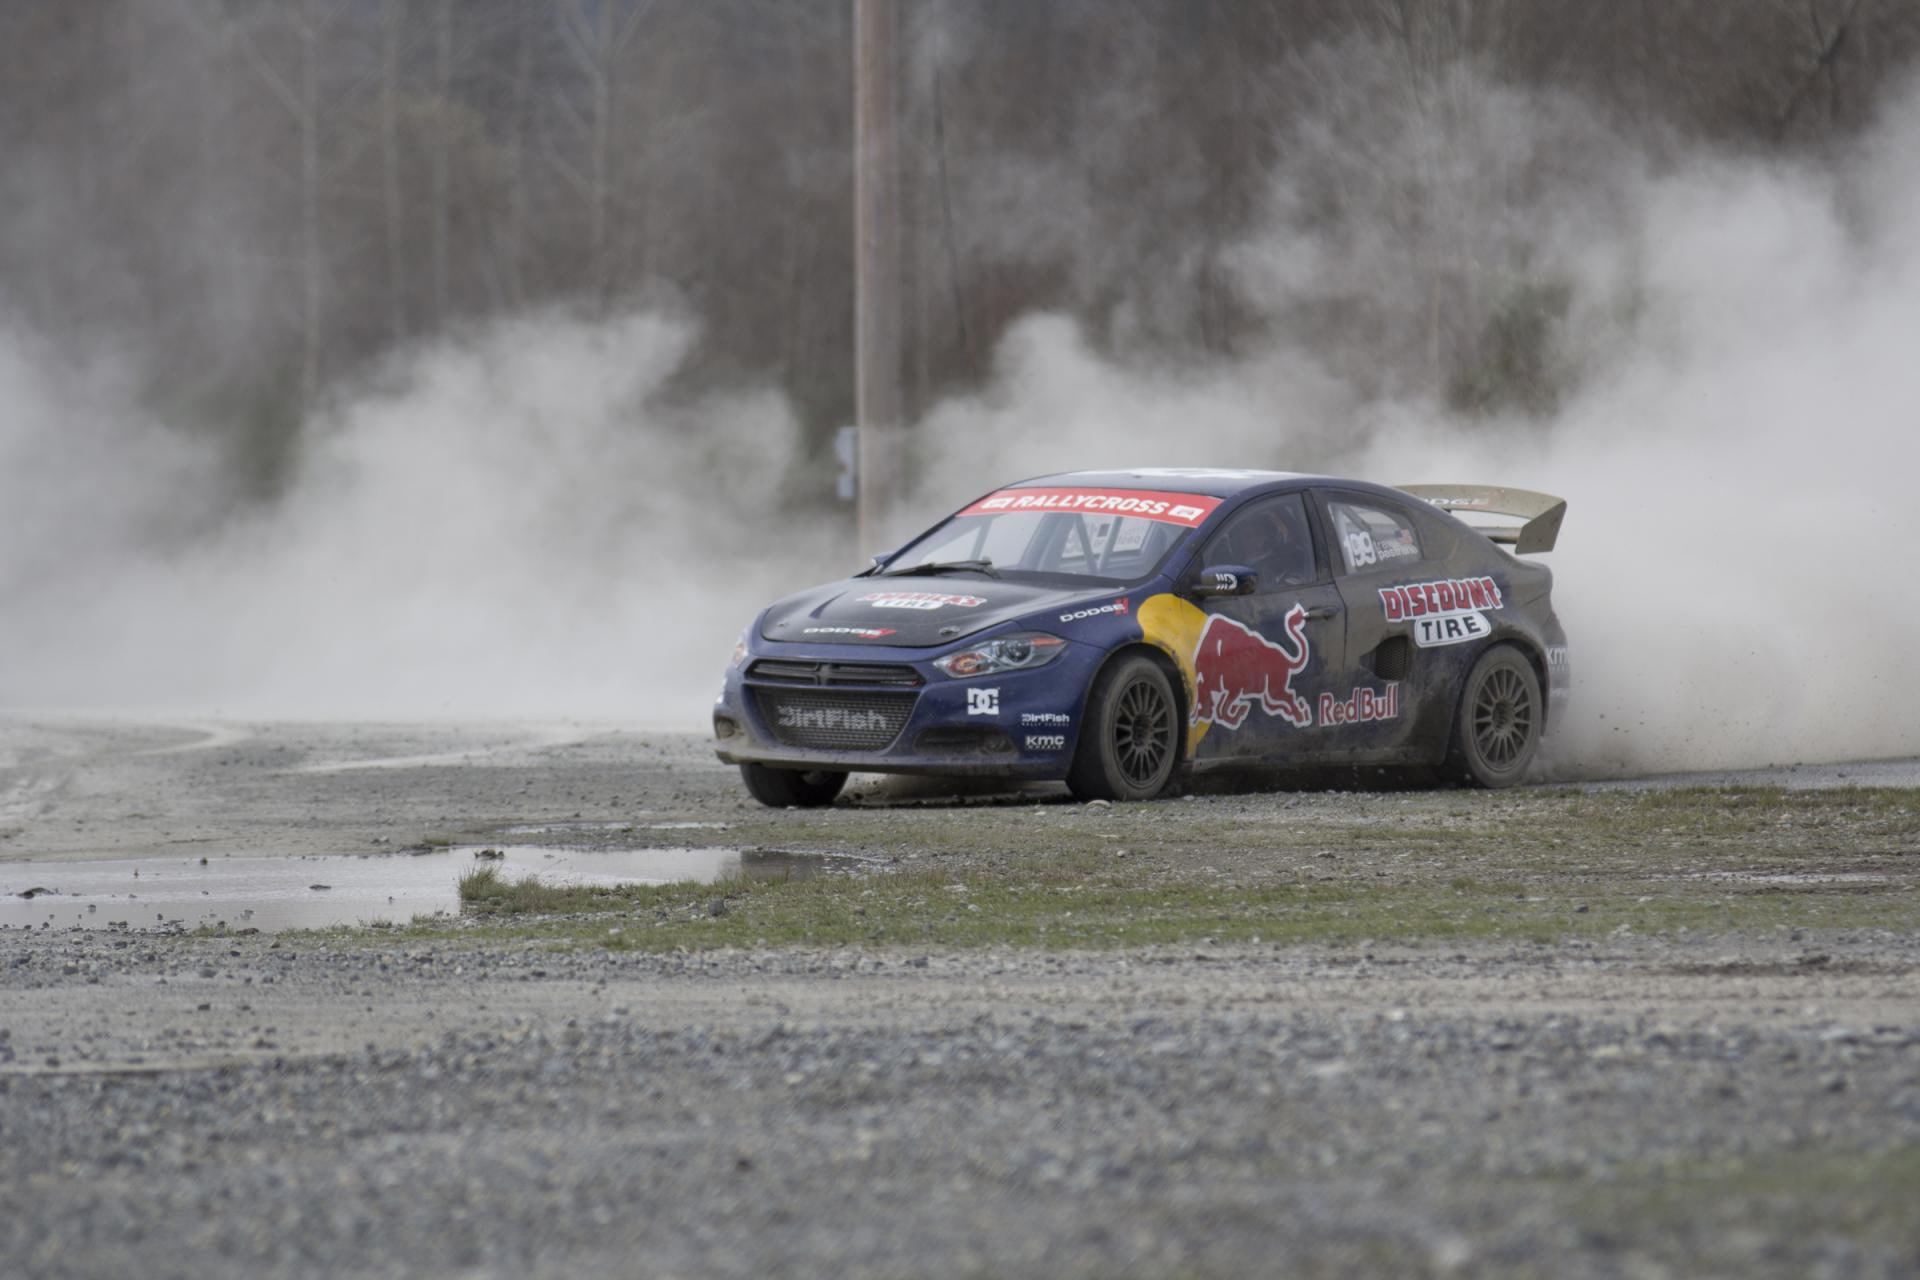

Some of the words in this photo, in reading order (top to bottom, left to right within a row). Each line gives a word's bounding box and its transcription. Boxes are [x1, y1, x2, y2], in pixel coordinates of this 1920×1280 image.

[1012, 495, 1170, 515] RALLYCROSS
[1343, 531, 1377, 567] 199
[1379, 577, 1503, 622] DISCOUNT
[1060, 604, 1125, 622] DODGE
[803, 627, 881, 636] DODGE
[1421, 615, 1482, 641] TIRE
[967, 687, 999, 715] DC
[1319, 692, 1360, 727] Red
[1360, 682, 1399, 722] Bull
[1021, 713, 1070, 723] DirtFish
